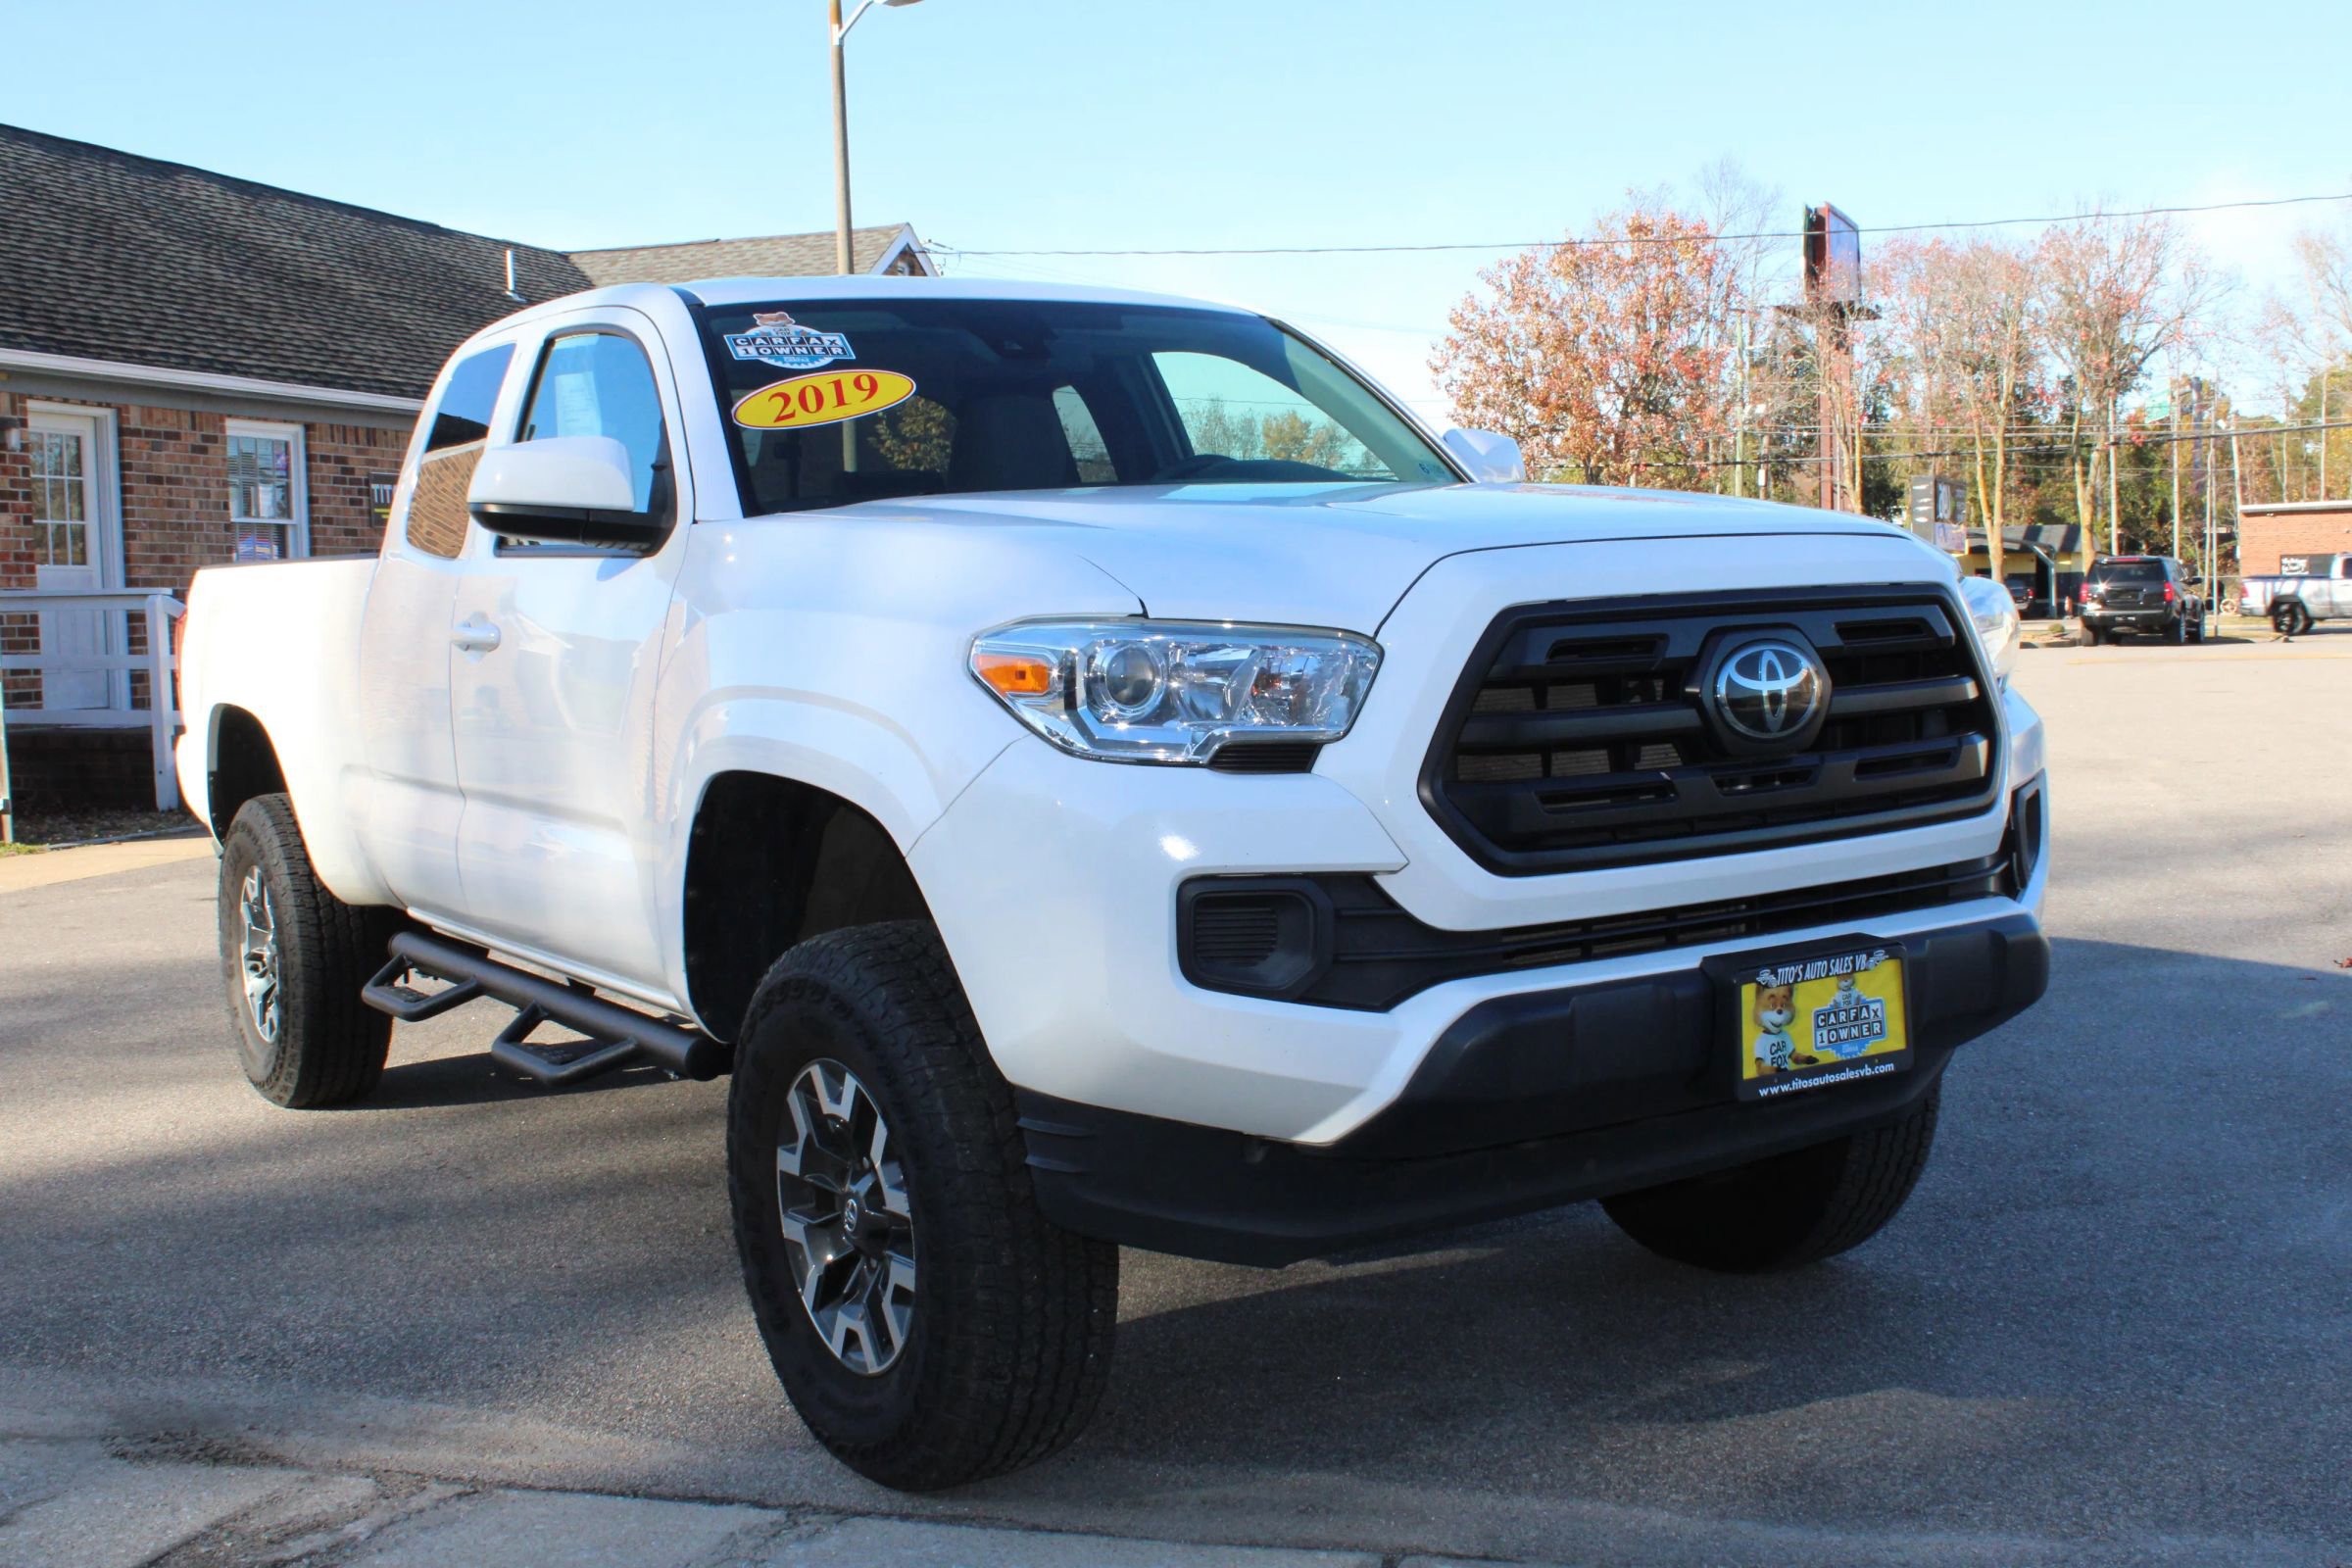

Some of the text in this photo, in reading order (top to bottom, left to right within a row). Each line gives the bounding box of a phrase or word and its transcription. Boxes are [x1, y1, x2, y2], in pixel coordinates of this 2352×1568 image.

[736, 336, 840, 346] CARFAX
[759, 346, 844, 355] OWNER
[767, 373, 879, 423] 2019
[370, 484, 396, 504] TIT
[1777, 954, 1867, 986] TITO'S AUTO SALES VB
[1818, 1006, 1880, 1026] CARFAX
[1819, 1022, 1881, 1044] 1 OWNER
[1769, 1041, 1787, 1055] CAR
[1771, 1054, 1788, 1067] FOX
[1758, 1062, 1894, 1098] www.titosautosalesvb.com
